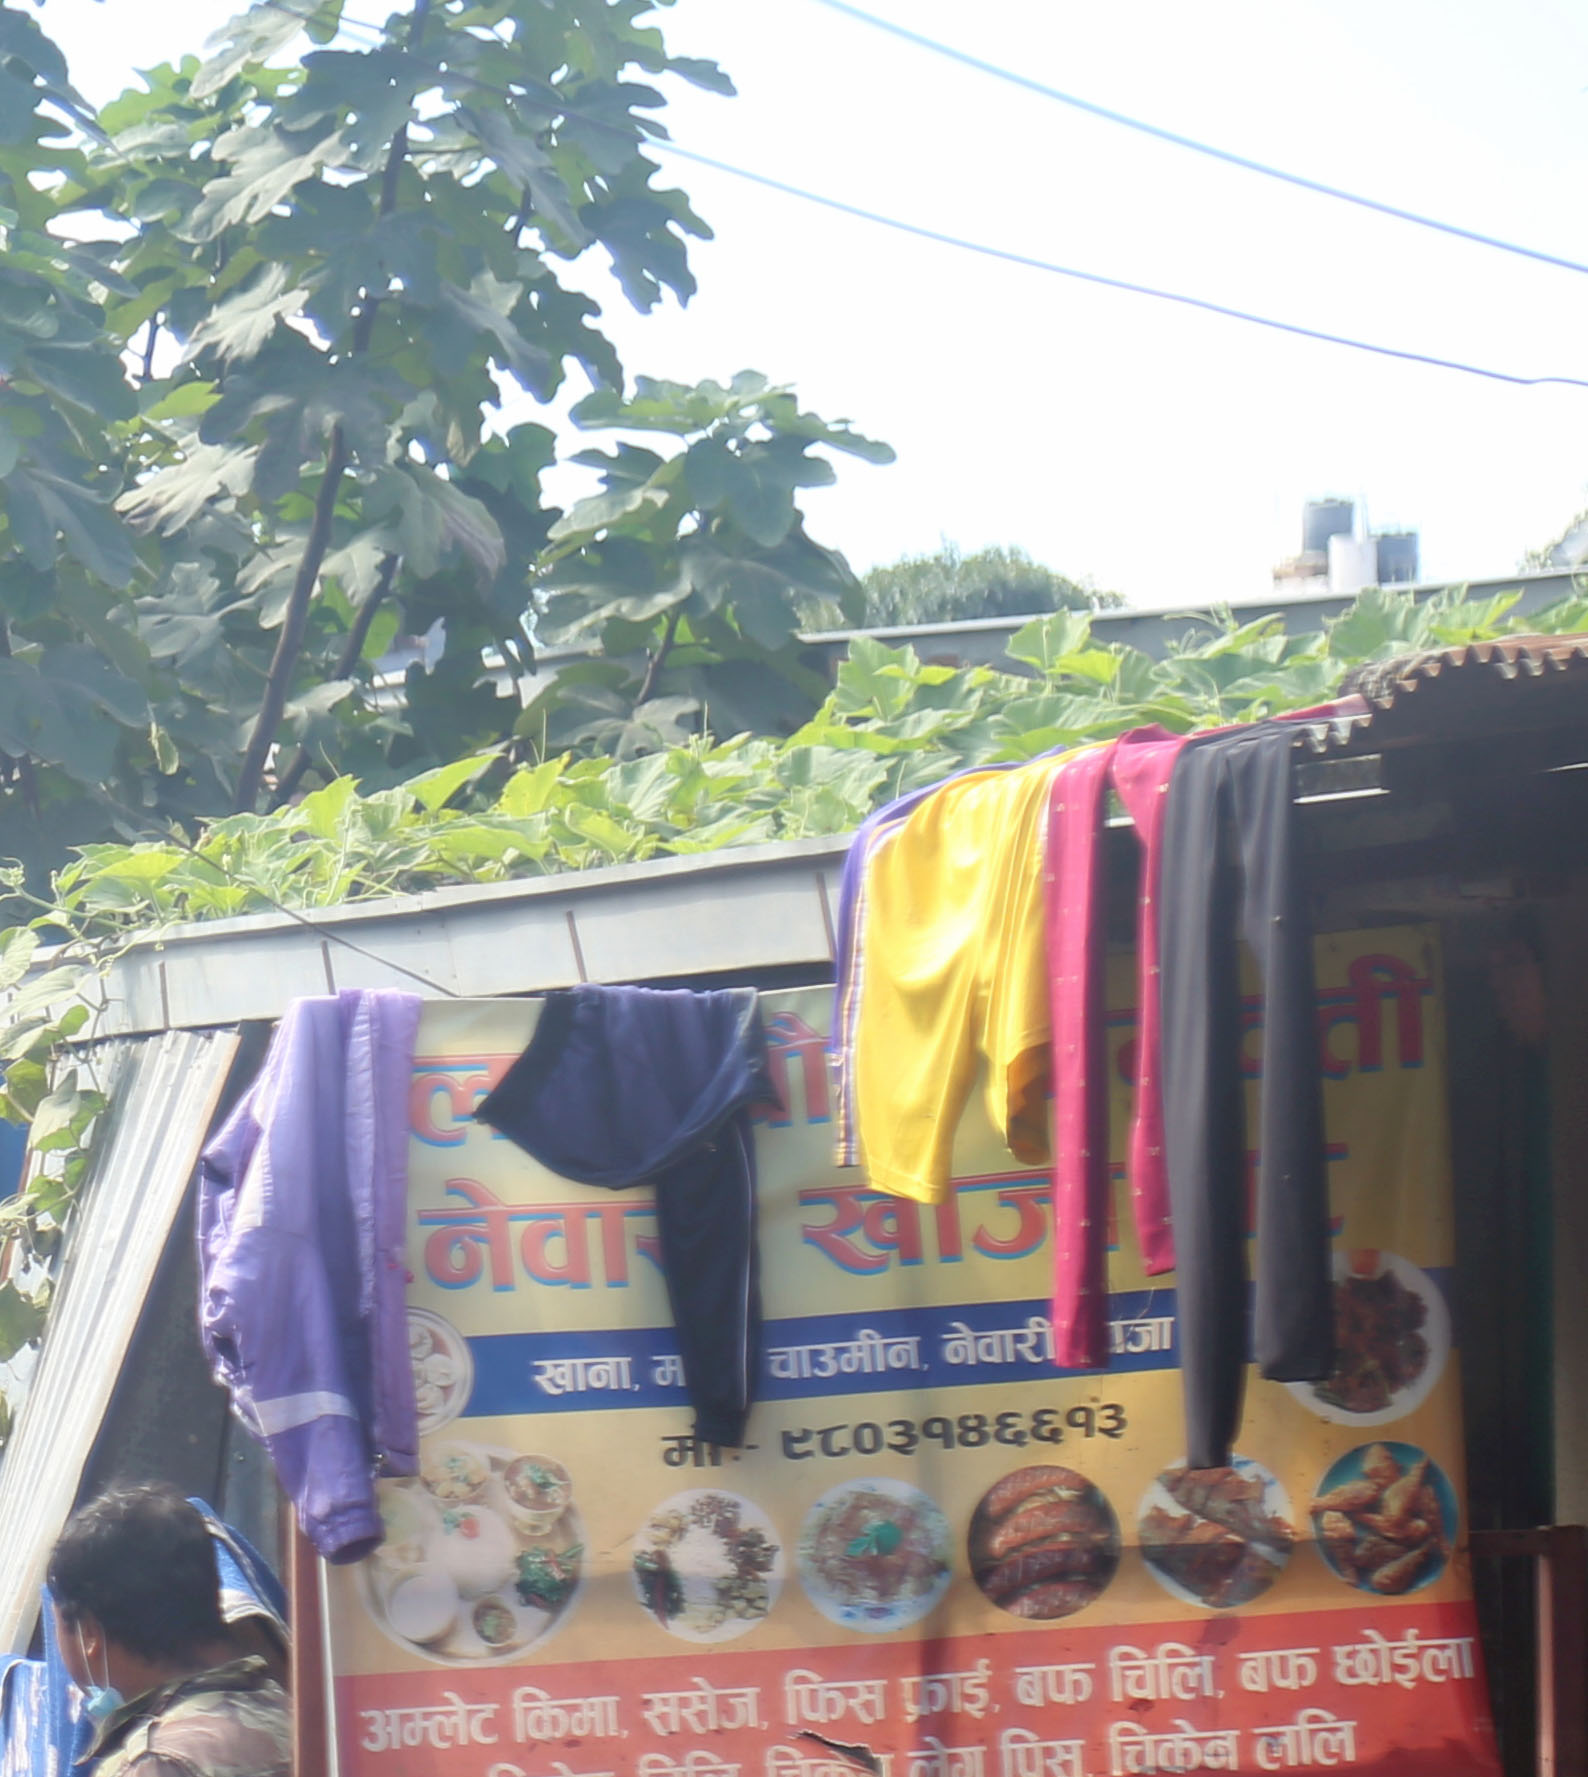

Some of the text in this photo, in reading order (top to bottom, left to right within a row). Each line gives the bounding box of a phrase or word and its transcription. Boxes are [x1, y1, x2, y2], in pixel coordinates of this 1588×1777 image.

[531, 1355, 640, 1397] खाना,
[767, 1328, 929, 1381] चाउमीन,
[780, 1403, 1129, 1461] ९८०३१४६६१३
[359, 1690, 501, 1754] अम्लेट
[512, 1685, 630, 1744] किमा,
[641, 1676, 768, 1735] ससेज,
[785, 1667, 889, 1725] फिस
[1014, 1662, 1097, 1708] बफ
[1108, 1642, 1224, 1703] चिलि,
[1237, 1646, 1321, 1693] बफ
[1331, 1628, 1476, 1690] छोईला
[1107, 1718, 1241, 1777] चिकेन
[1250, 1707, 1358, 1772] ललि
